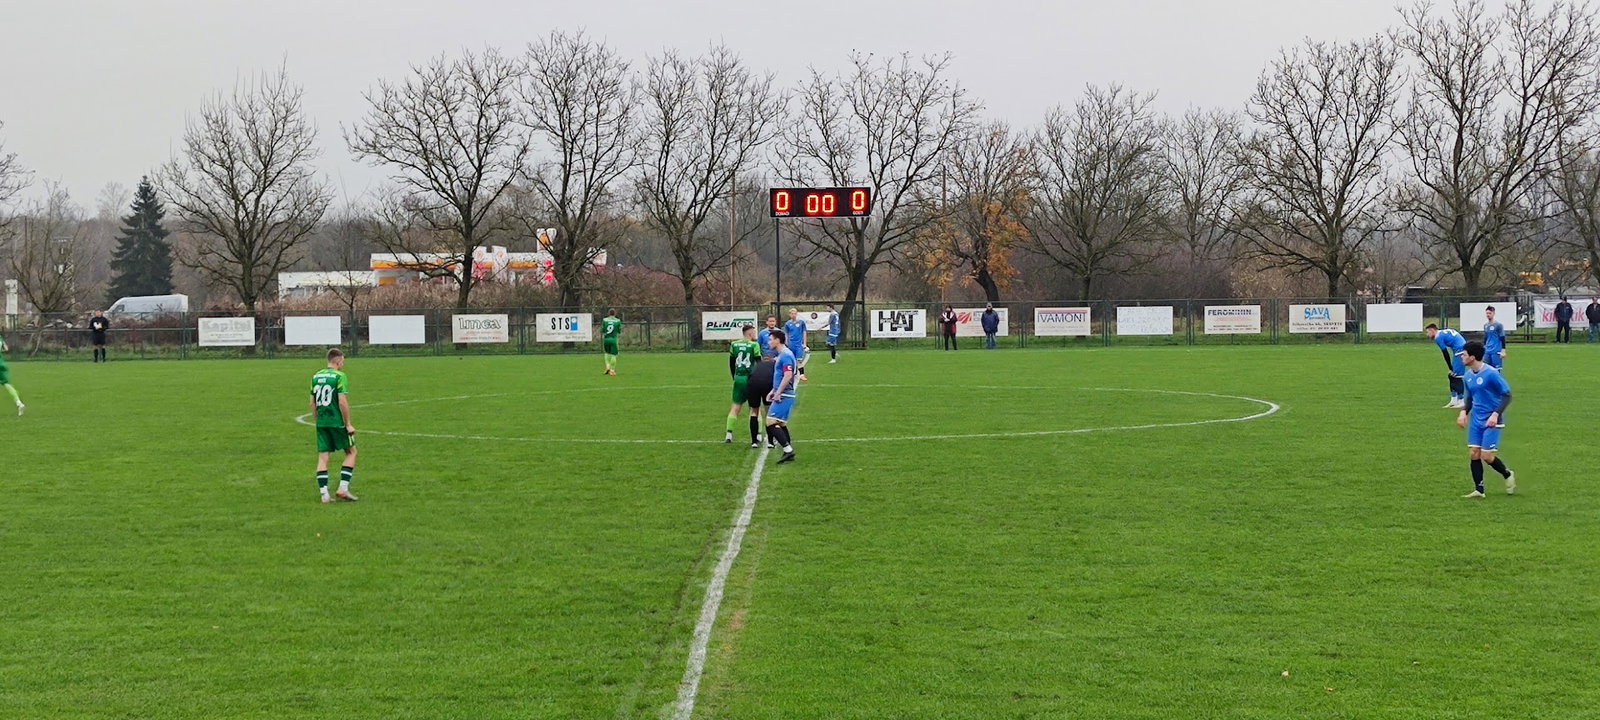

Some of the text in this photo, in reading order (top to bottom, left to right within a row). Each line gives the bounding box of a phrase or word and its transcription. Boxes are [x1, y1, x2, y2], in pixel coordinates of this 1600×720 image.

[776, 191, 789, 211] 0
[852, 190, 865, 210] 0
[878, 310, 919, 332] HAT
[1037, 310, 1087, 323] IVAMONT
[1304, 307, 1331, 320] SAVA
[551, 317, 570, 330] STS
[735, 351, 752, 369] 44
[313, 384, 333, 407] 20
